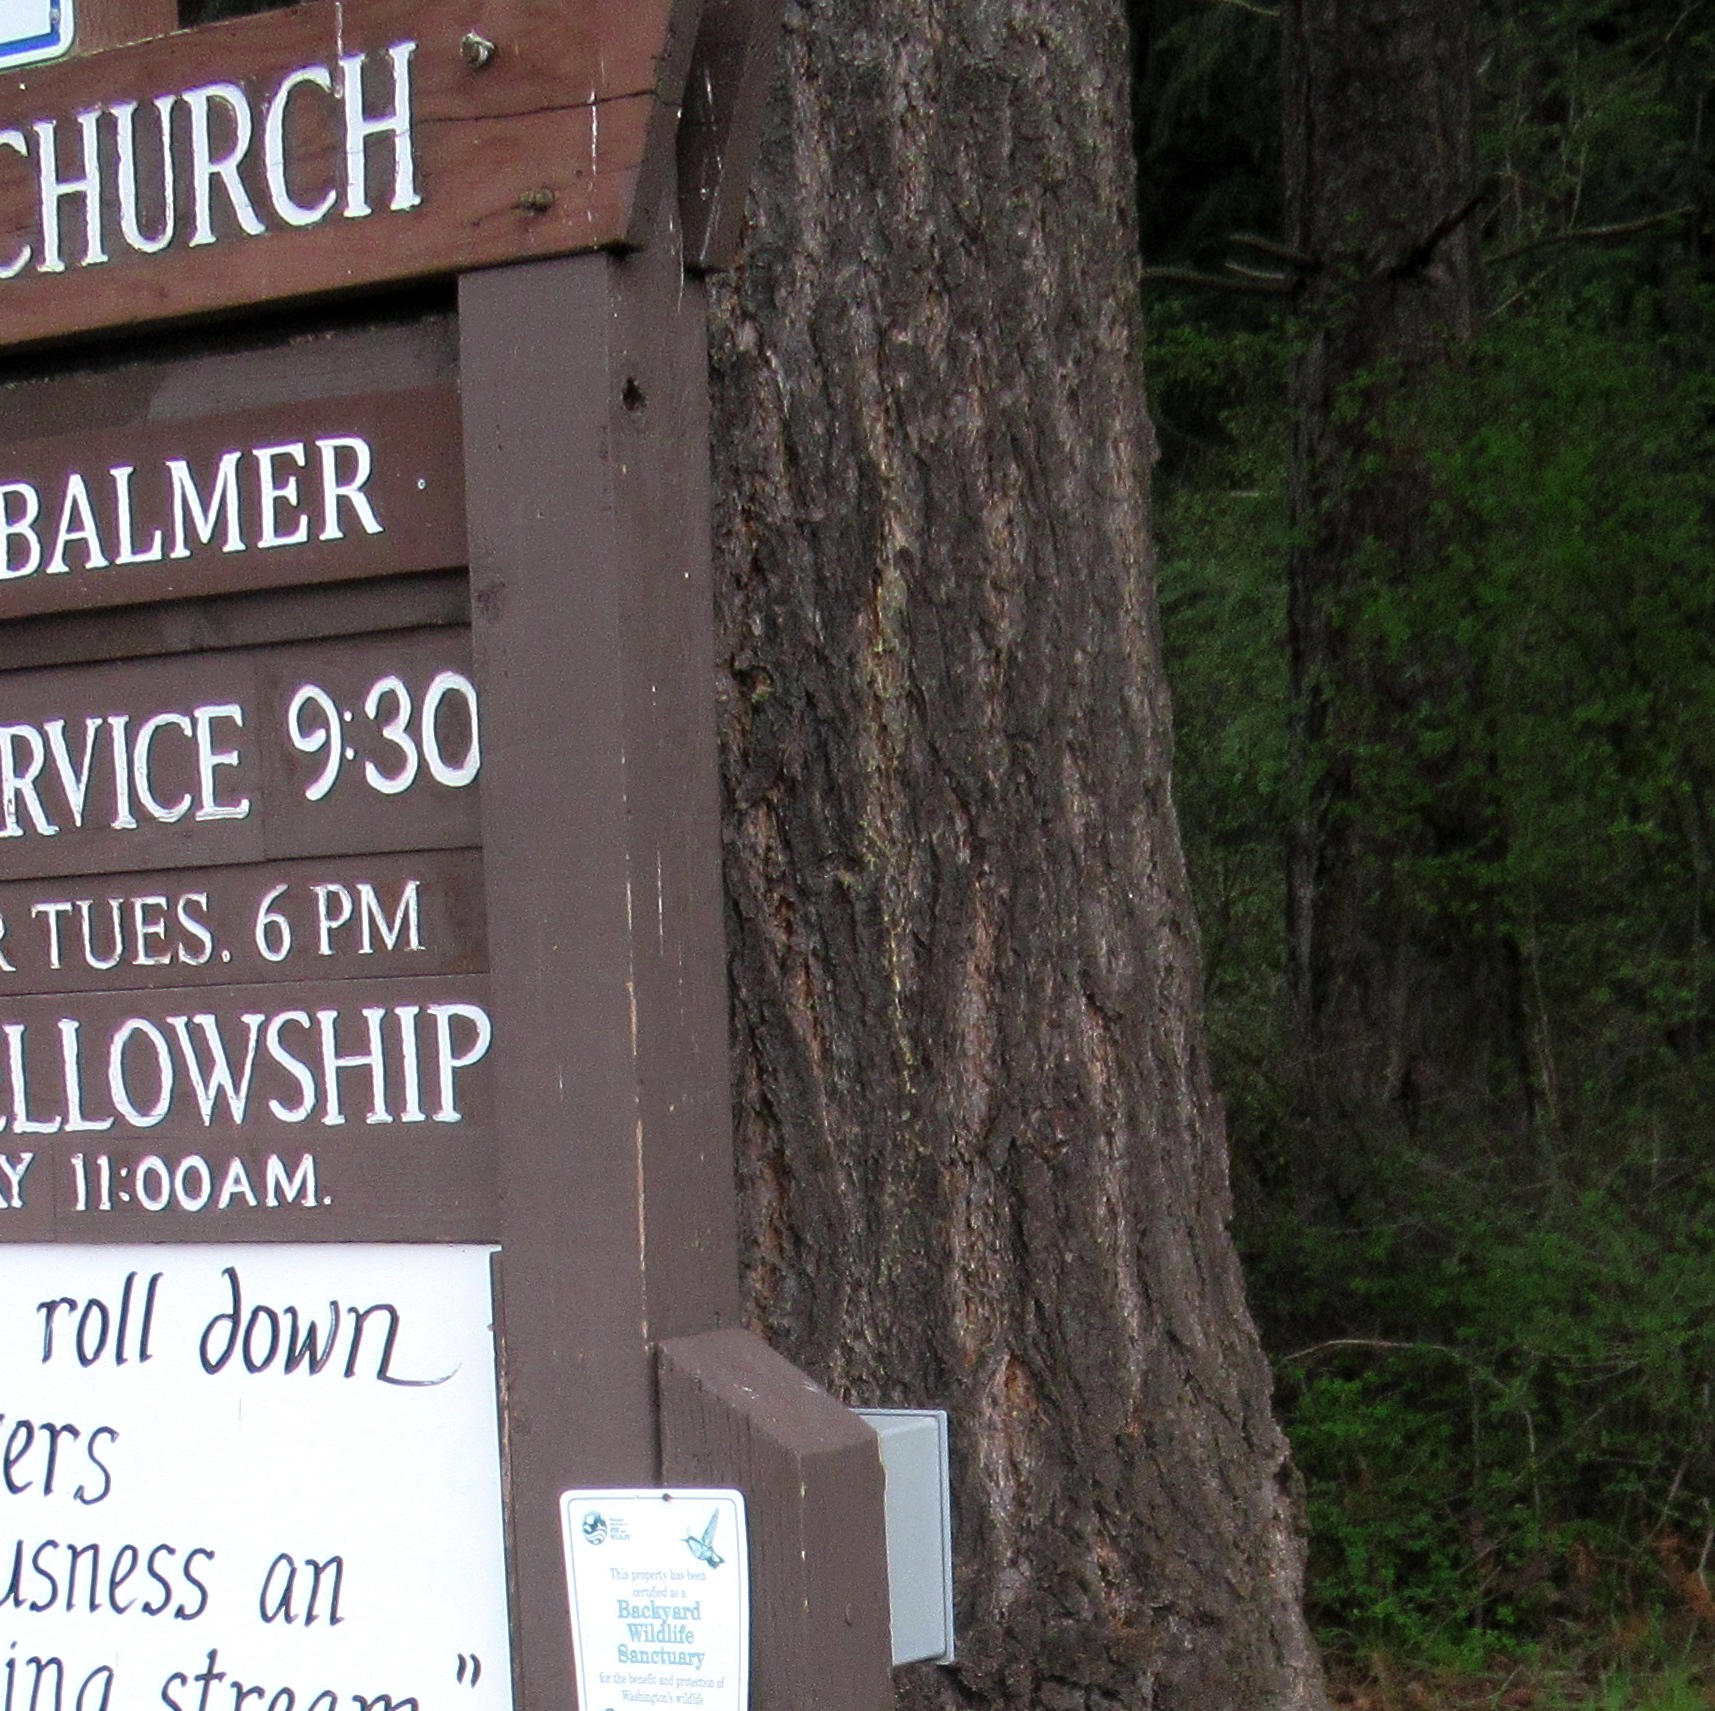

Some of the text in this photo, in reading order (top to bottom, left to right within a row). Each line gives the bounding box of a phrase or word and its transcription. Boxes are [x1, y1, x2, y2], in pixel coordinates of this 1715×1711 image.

[289, 671, 480, 800] 9:30
[32, 893, 230, 969] TUES.
[256, 885, 290, 961] 6
[310, 881, 425, 955] PM
[71, 1153, 331, 1211] 11:00AM.
[37, 1272, 162, 1367] roll
[199, 1267, 460, 1386] down
[260, 1553, 342, 1626] an
[617, 1600, 701, 1624] Backyard
[618, 1644, 705, 1670] Sanctuary
[627, 1623, 694, 1644] Wildlife
